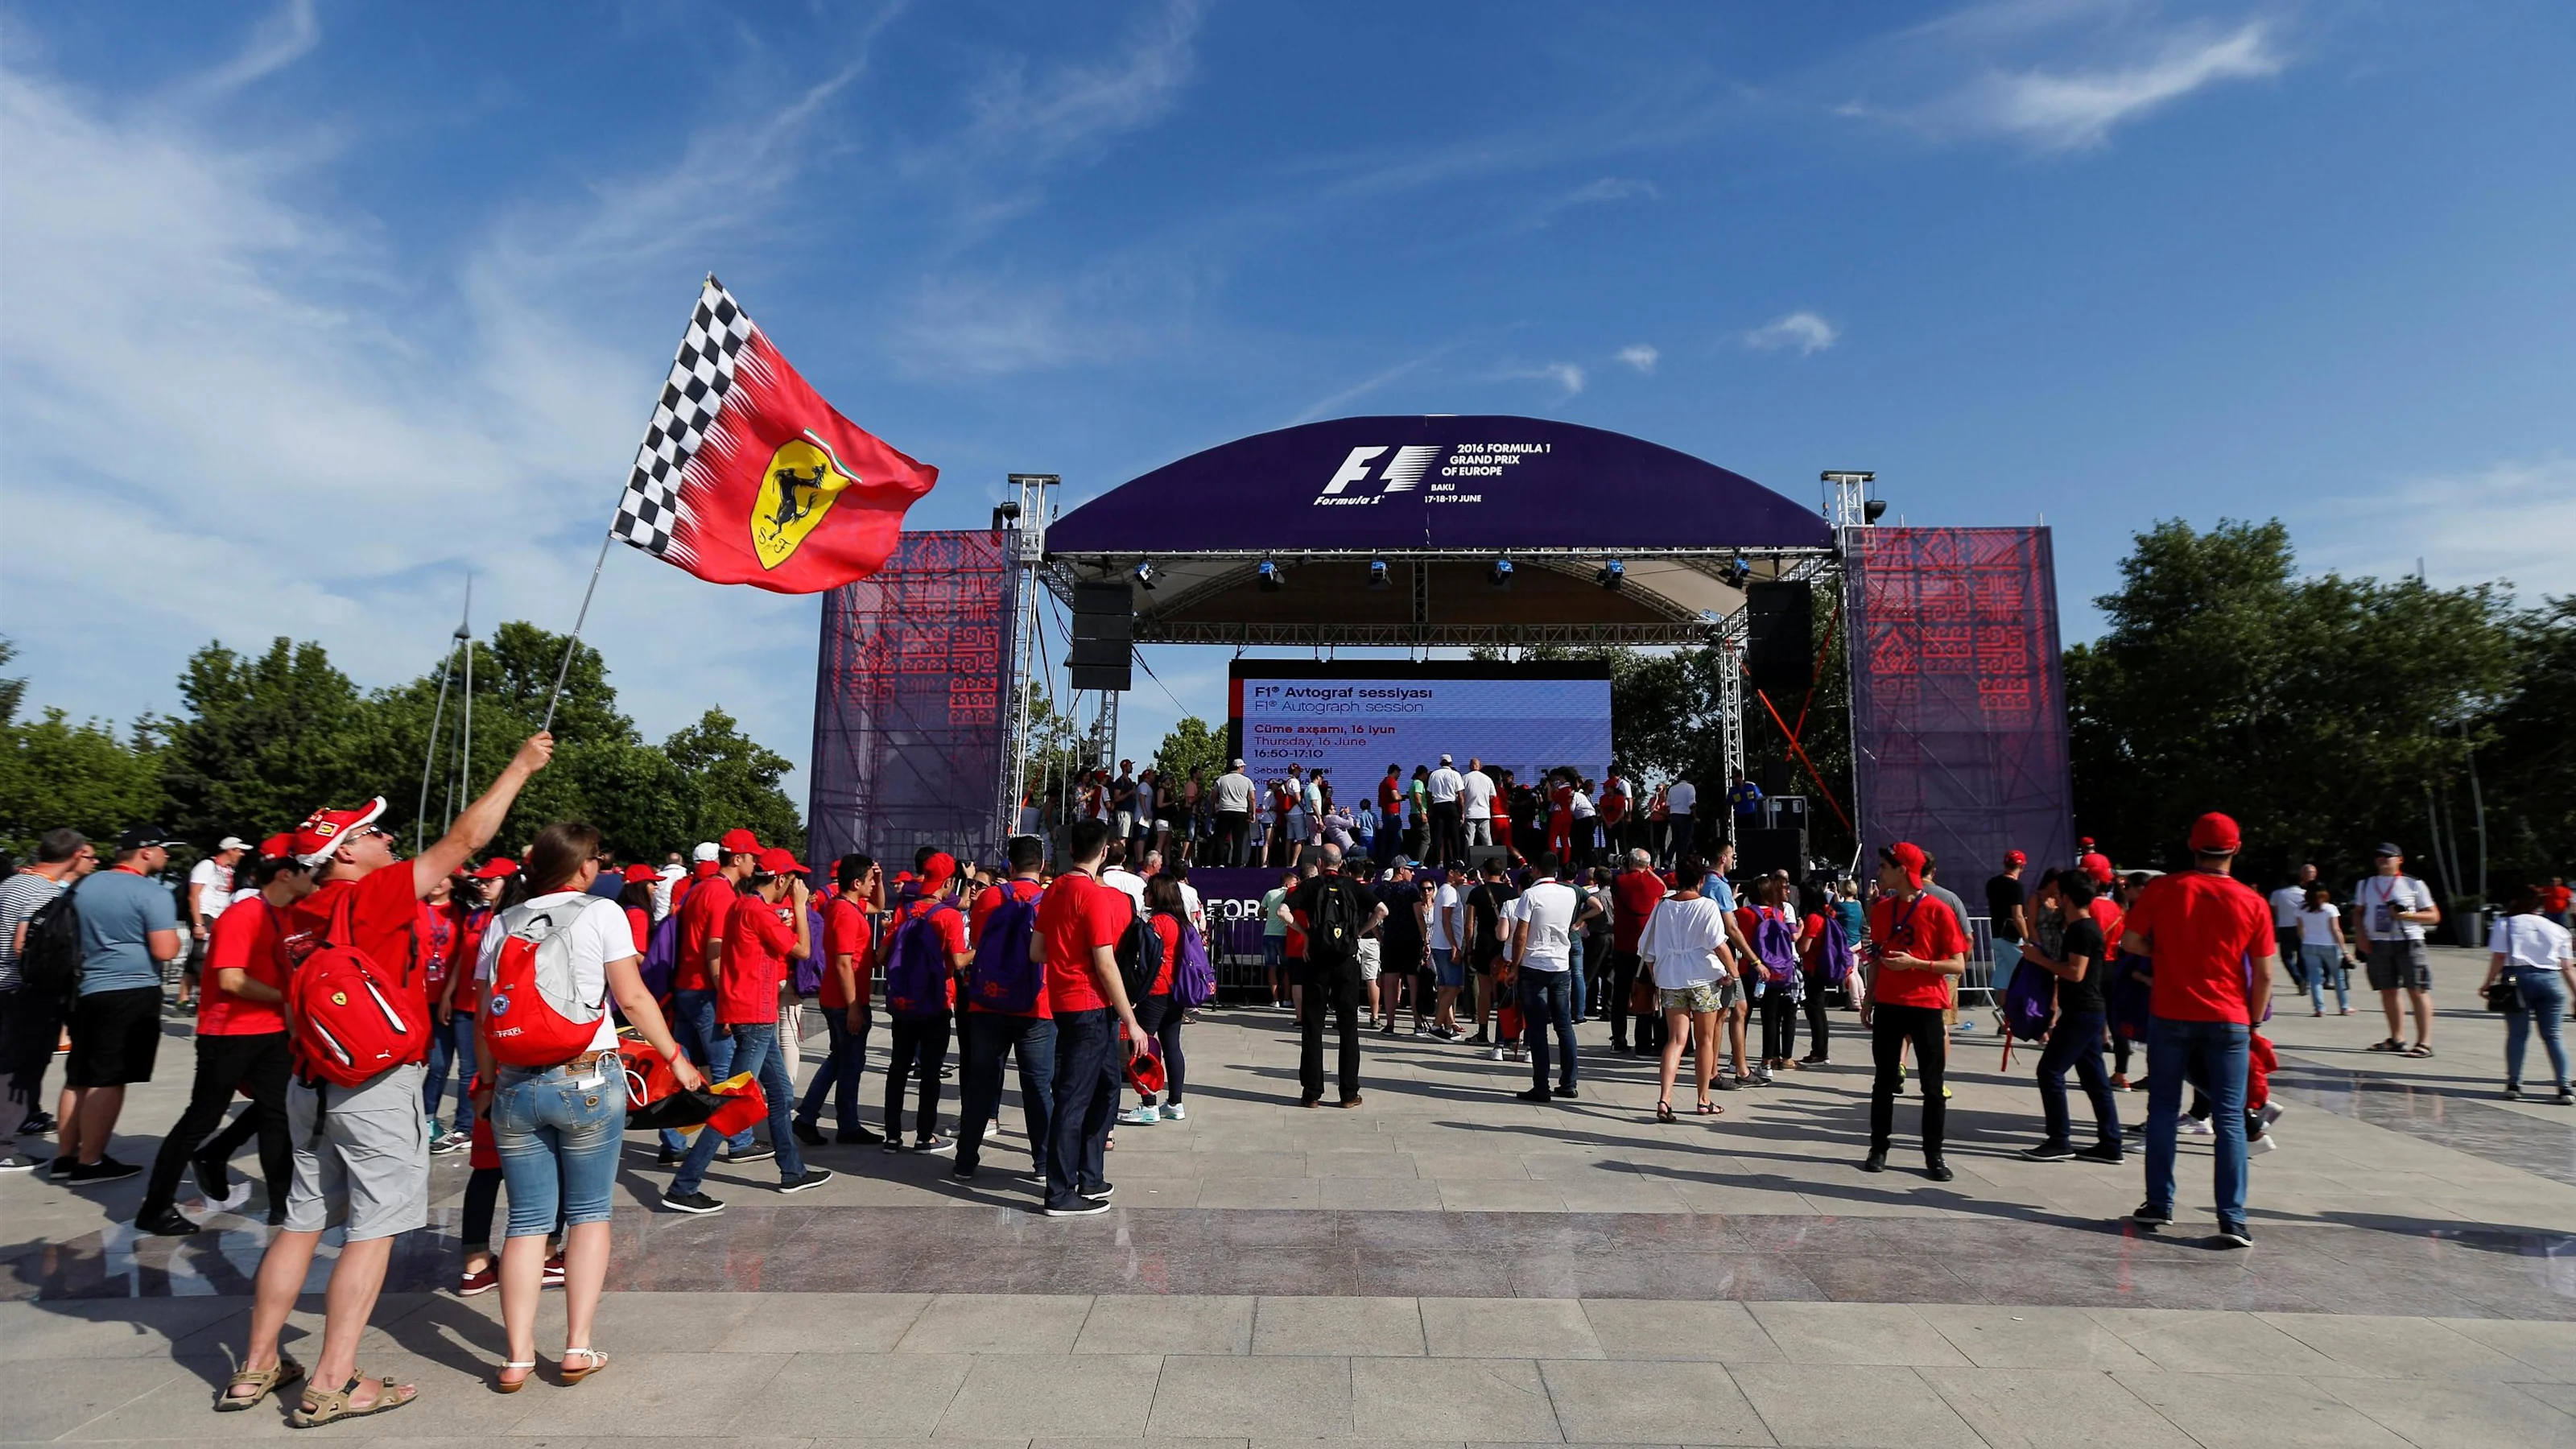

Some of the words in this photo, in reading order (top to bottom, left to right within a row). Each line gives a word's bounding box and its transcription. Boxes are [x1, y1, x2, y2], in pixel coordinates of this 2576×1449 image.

[1457, 444, 1484, 453] 2016
[1487, 444, 1543, 453] FORMULA
[1546, 444, 1551, 452] 1
[1450, 455, 1492, 464] GRAND
[1494, 455, 1520, 464] PRIX
[1441, 466, 1458, 477] OF
[1459, 466, 1503, 476] EUROPE
[1430, 483, 1455, 492] BAKU
[1314, 495, 1371, 506] Formula
[1424, 495, 1458, 503] 17-18-19
[1459, 494, 1482, 502] JUNE
[1285, 687, 1354, 700] Avtograf
[1359, 687, 1432, 700] sessiyası
[1282, 700, 1360, 715] Autograph
[1365, 701, 1424, 712] session
[1352, 724, 1364, 733] 16
[1368, 724, 1396, 736] iyun
[1254, 737, 1315, 748] Thursday,
[1319, 737, 1331, 746] 16
[1335, 737, 1367, 746] June
[1254, 749, 1323, 758] 16:50-17:10
